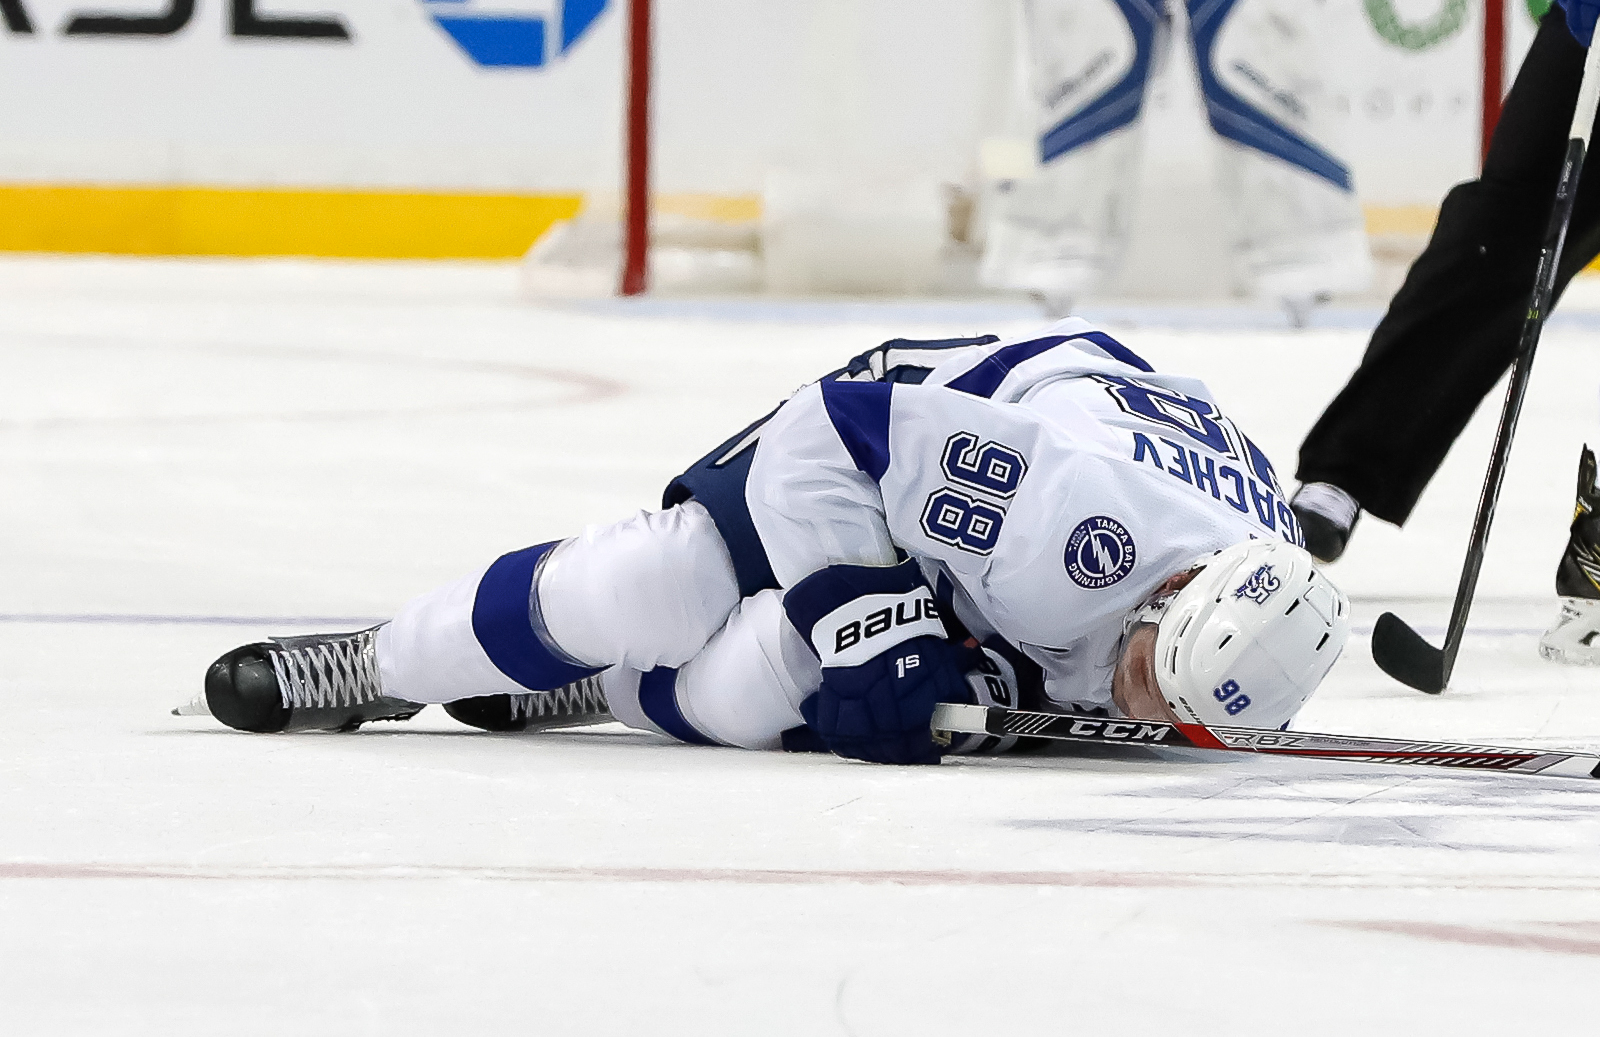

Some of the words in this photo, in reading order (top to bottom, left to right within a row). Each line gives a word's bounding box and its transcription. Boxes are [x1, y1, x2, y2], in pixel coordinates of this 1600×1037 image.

[919, 430, 1028, 557] 98
[1095, 518, 1128, 543] TAMPA
[1123, 545, 1133, 569] BAY
[1068, 562, 1124, 587] LIGHTNING
[1213, 679, 1252, 716] 98
[1069, 719, 1173, 741] CCM
